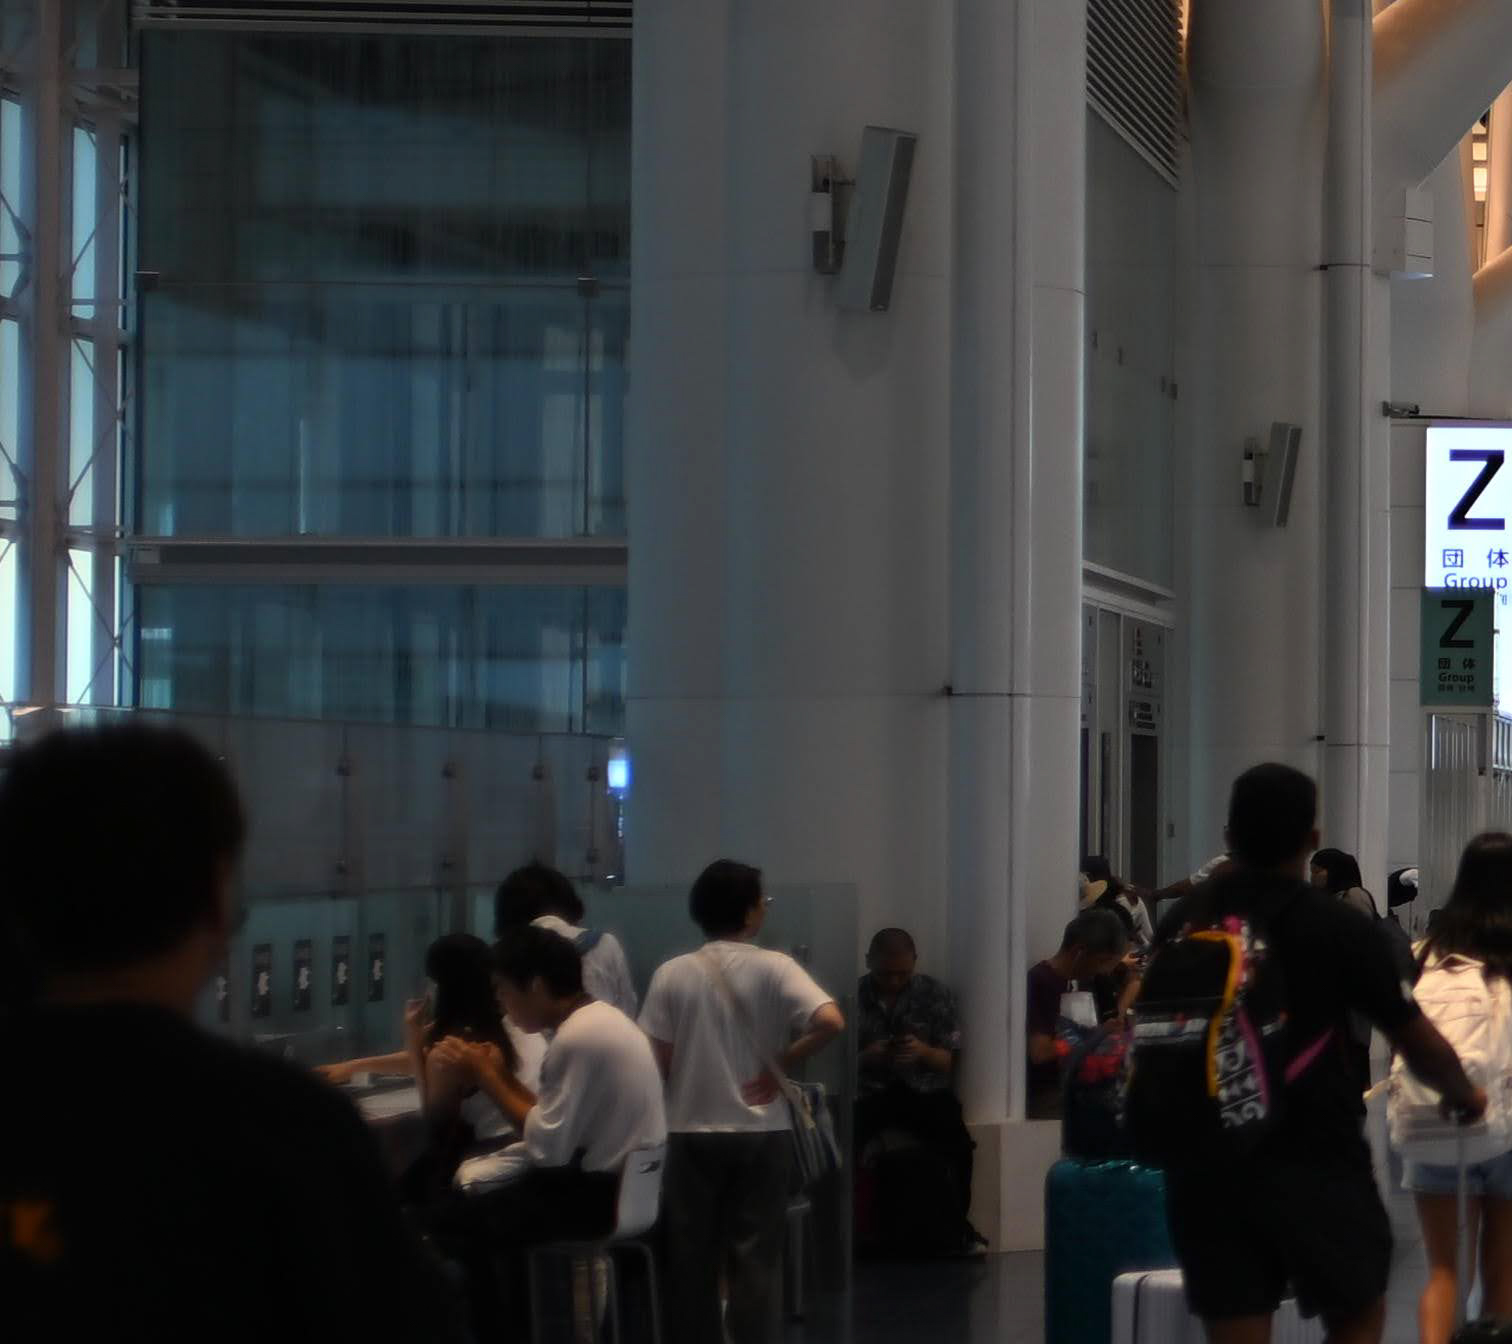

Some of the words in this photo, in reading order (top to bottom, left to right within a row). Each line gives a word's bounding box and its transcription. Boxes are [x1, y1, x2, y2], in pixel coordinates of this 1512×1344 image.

[1447, 448, 1506, 531] Z
[1443, 572, 1509, 591] Group
[1439, 599, 1475, 649] Z
[1437, 672, 1475, 686] Group
